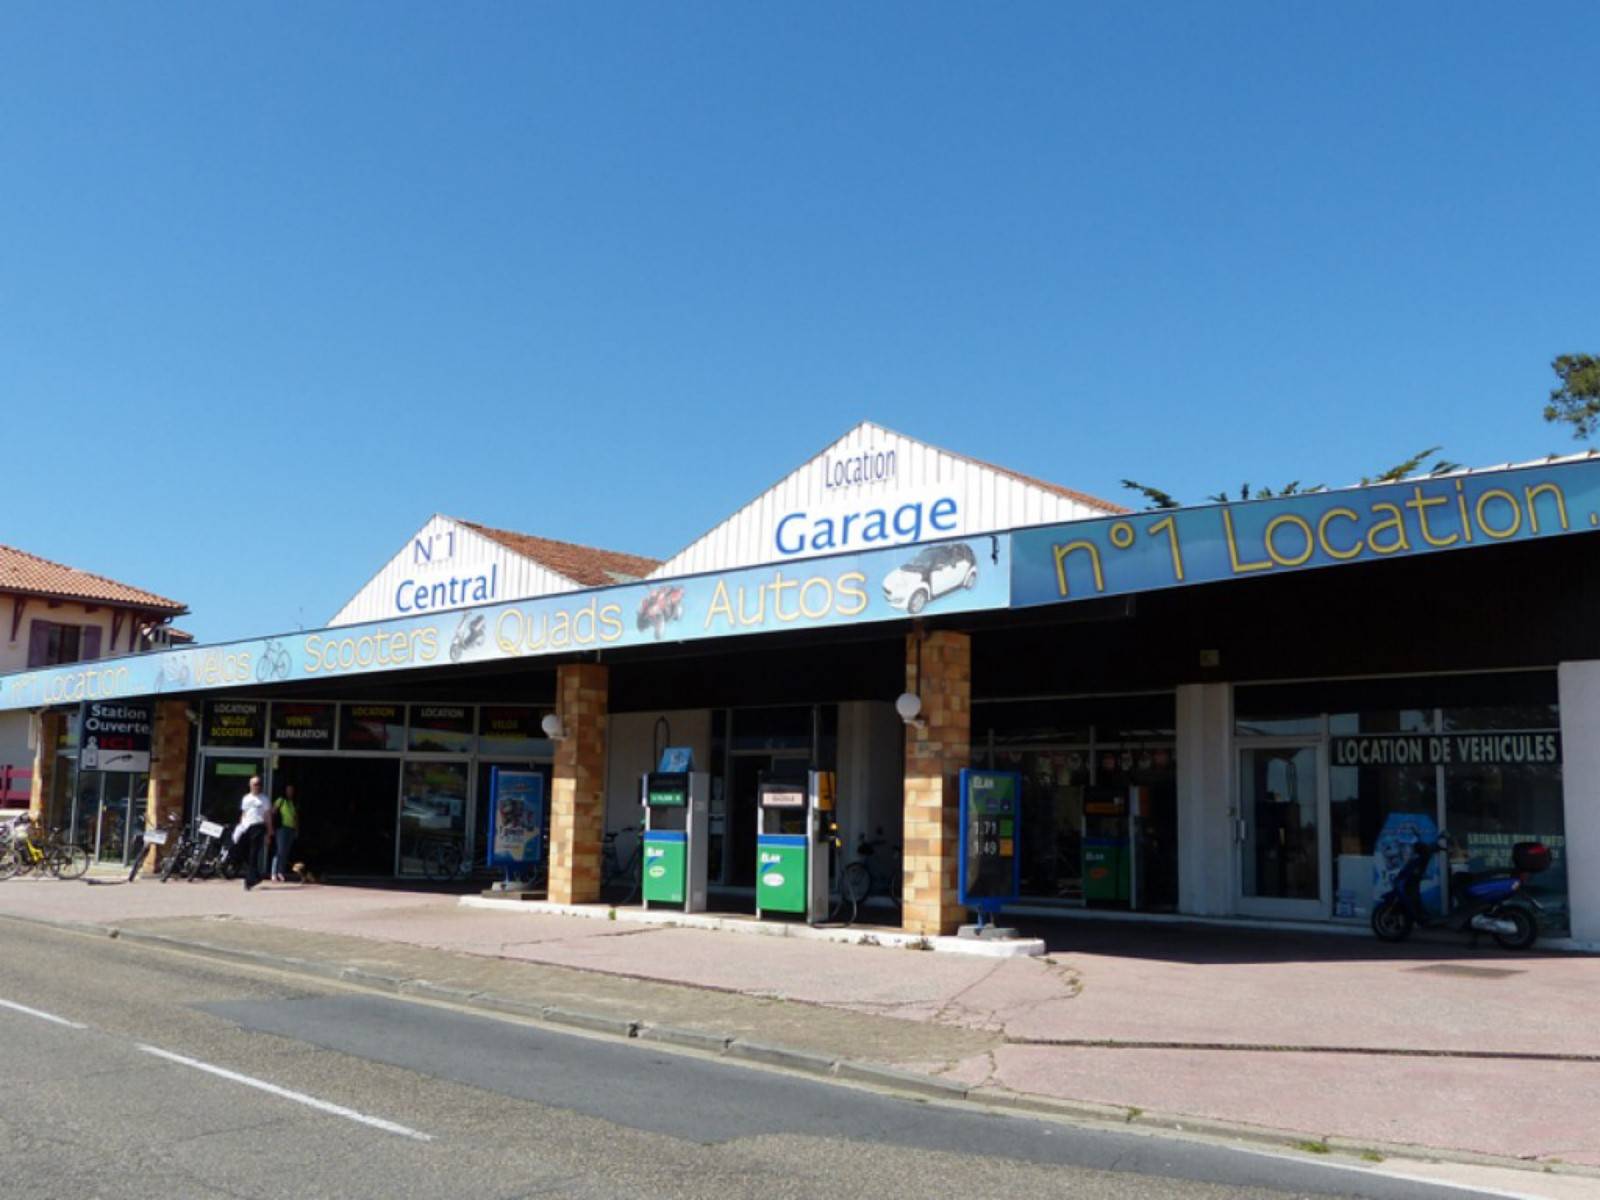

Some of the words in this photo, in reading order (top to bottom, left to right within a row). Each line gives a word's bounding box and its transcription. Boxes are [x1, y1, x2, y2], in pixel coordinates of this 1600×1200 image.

[825, 448, 896, 489] Location
[775, 497, 958, 555] Garage
[1053, 515, 1184, 597] n°1
[1222, 478, 1570, 574] Location
[396, 563, 497, 613] Central
[703, 570, 869, 630] Autos
[494, 596, 624, 655] Quads
[303, 626, 440, 673] Scooters
[44, 664, 129, 703] Location
[85, 717, 150, 734] Ouverte
[91, 703, 147, 720] Station
[213, 704, 257, 713] LOCATION
[420, 709, 465, 718] LOCATION
[1337, 738, 1423, 764] LOCATION
[1430, 737, 1450, 763] DE
[1457, 735, 1557, 763] VEHICULES
